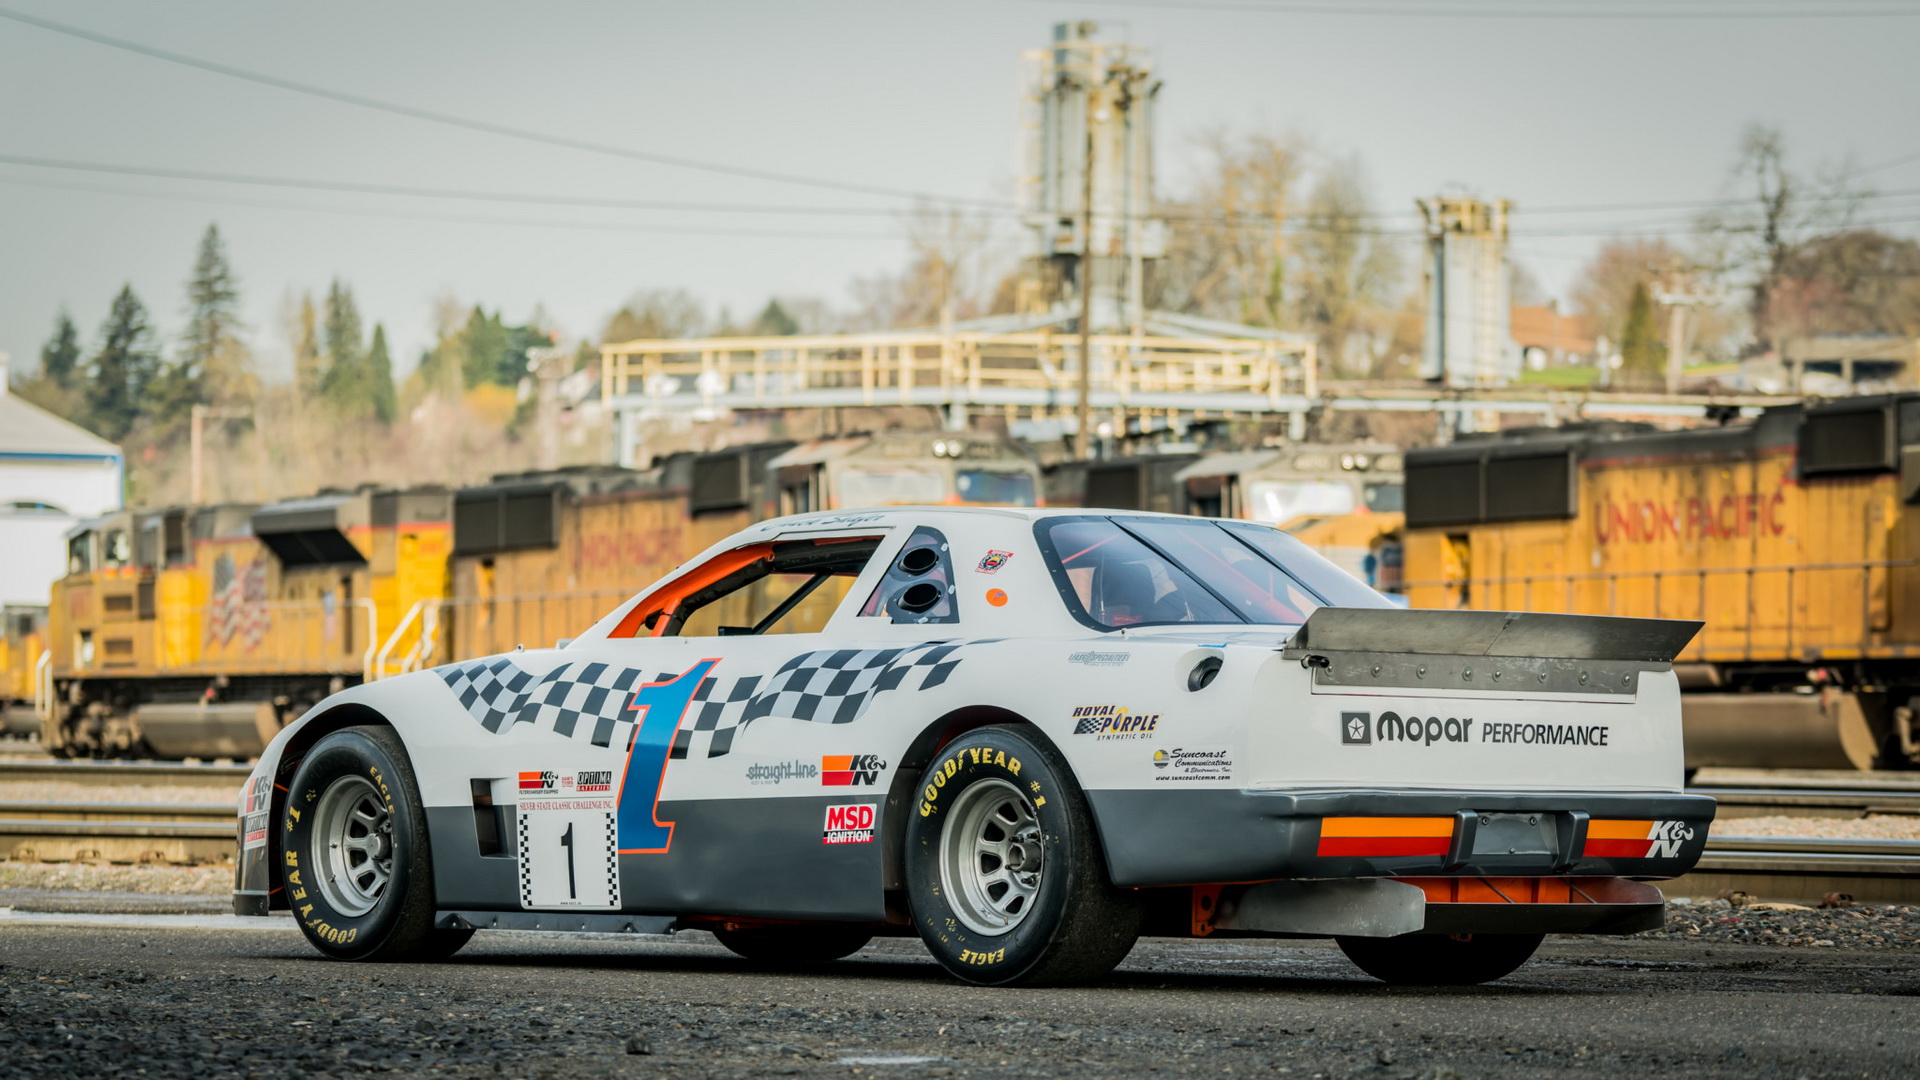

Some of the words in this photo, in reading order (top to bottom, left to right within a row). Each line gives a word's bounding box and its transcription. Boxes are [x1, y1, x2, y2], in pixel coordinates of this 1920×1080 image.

[1594, 500, 1681, 545] UNION
[1687, 493, 1784, 540] PACIFIC
[1072, 704, 1116, 717] ROYAL
[1099, 712, 1160, 734] PURPLE
[1097, 733, 1136, 741] SYNTHETIC
[1482, 722, 1609, 746] PERFORMANCE
[616, 657, 723, 855] 1
[1170, 748, 1227, 758] Suncoast
[1174, 758, 1232, 767] Communications
[577, 771, 612, 785] OPTIMA
[919, 747, 1022, 818] GOODYEAR
[370, 766, 395, 815] EAGLE
[519, 801, 536, 810] SILVER
[536, 801, 552, 810] STATE
[551, 801, 572, 810] CLASSIC
[572, 800, 602, 810] CHALLENGE
[602, 800, 614, 809] INC.
[827, 806, 874, 830] MSD
[827, 830, 871, 844] IGNITION
[560, 822, 576, 899] 1
[959, 948, 1005, 965] EAGLE
